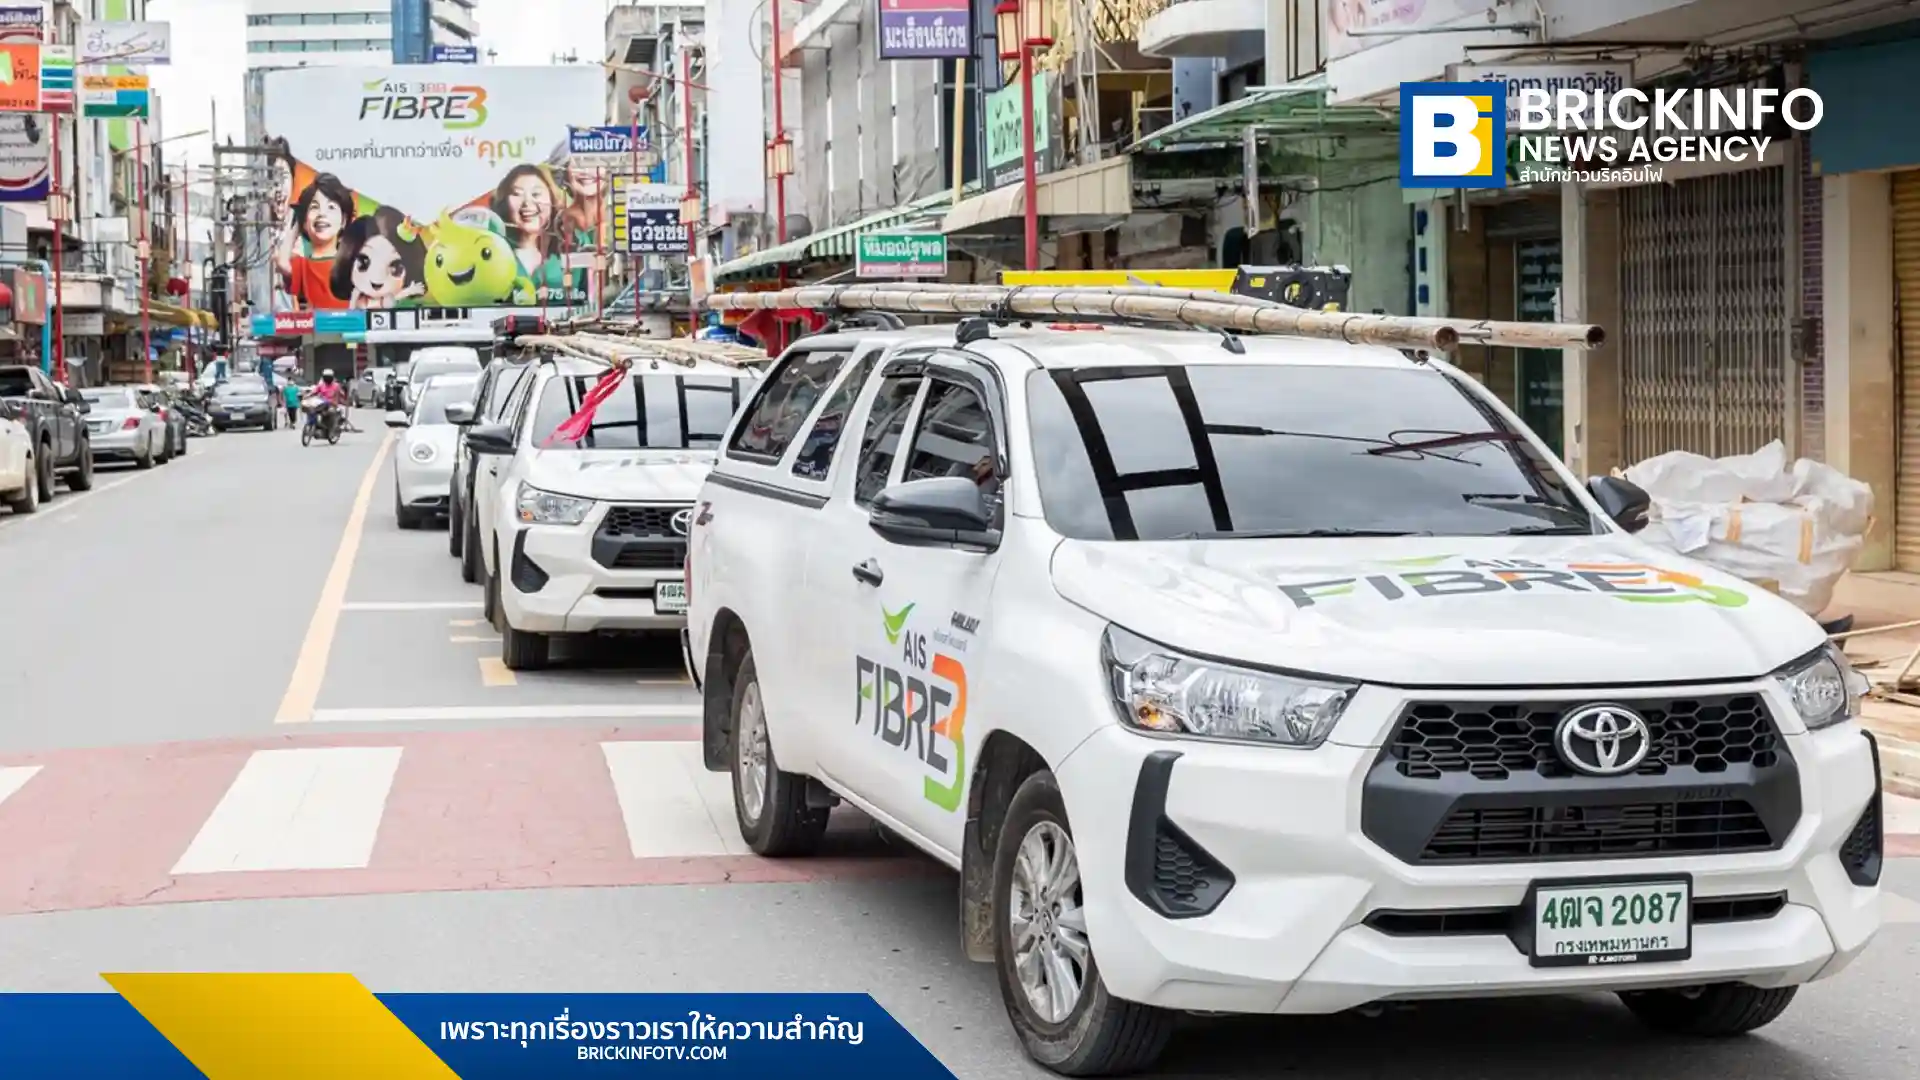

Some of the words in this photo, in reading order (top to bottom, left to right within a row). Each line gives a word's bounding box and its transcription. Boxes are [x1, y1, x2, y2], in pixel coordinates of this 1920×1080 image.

[384, 83, 407, 93] AIS
[315, 137, 463, 161] อนาคตที่มากกว่าเพื่อ
[904, 630, 927, 669] AIS
[1611, 892, 1682, 926] 2087
[1555, 935, 1669, 954] กรงเทพมหานคร
